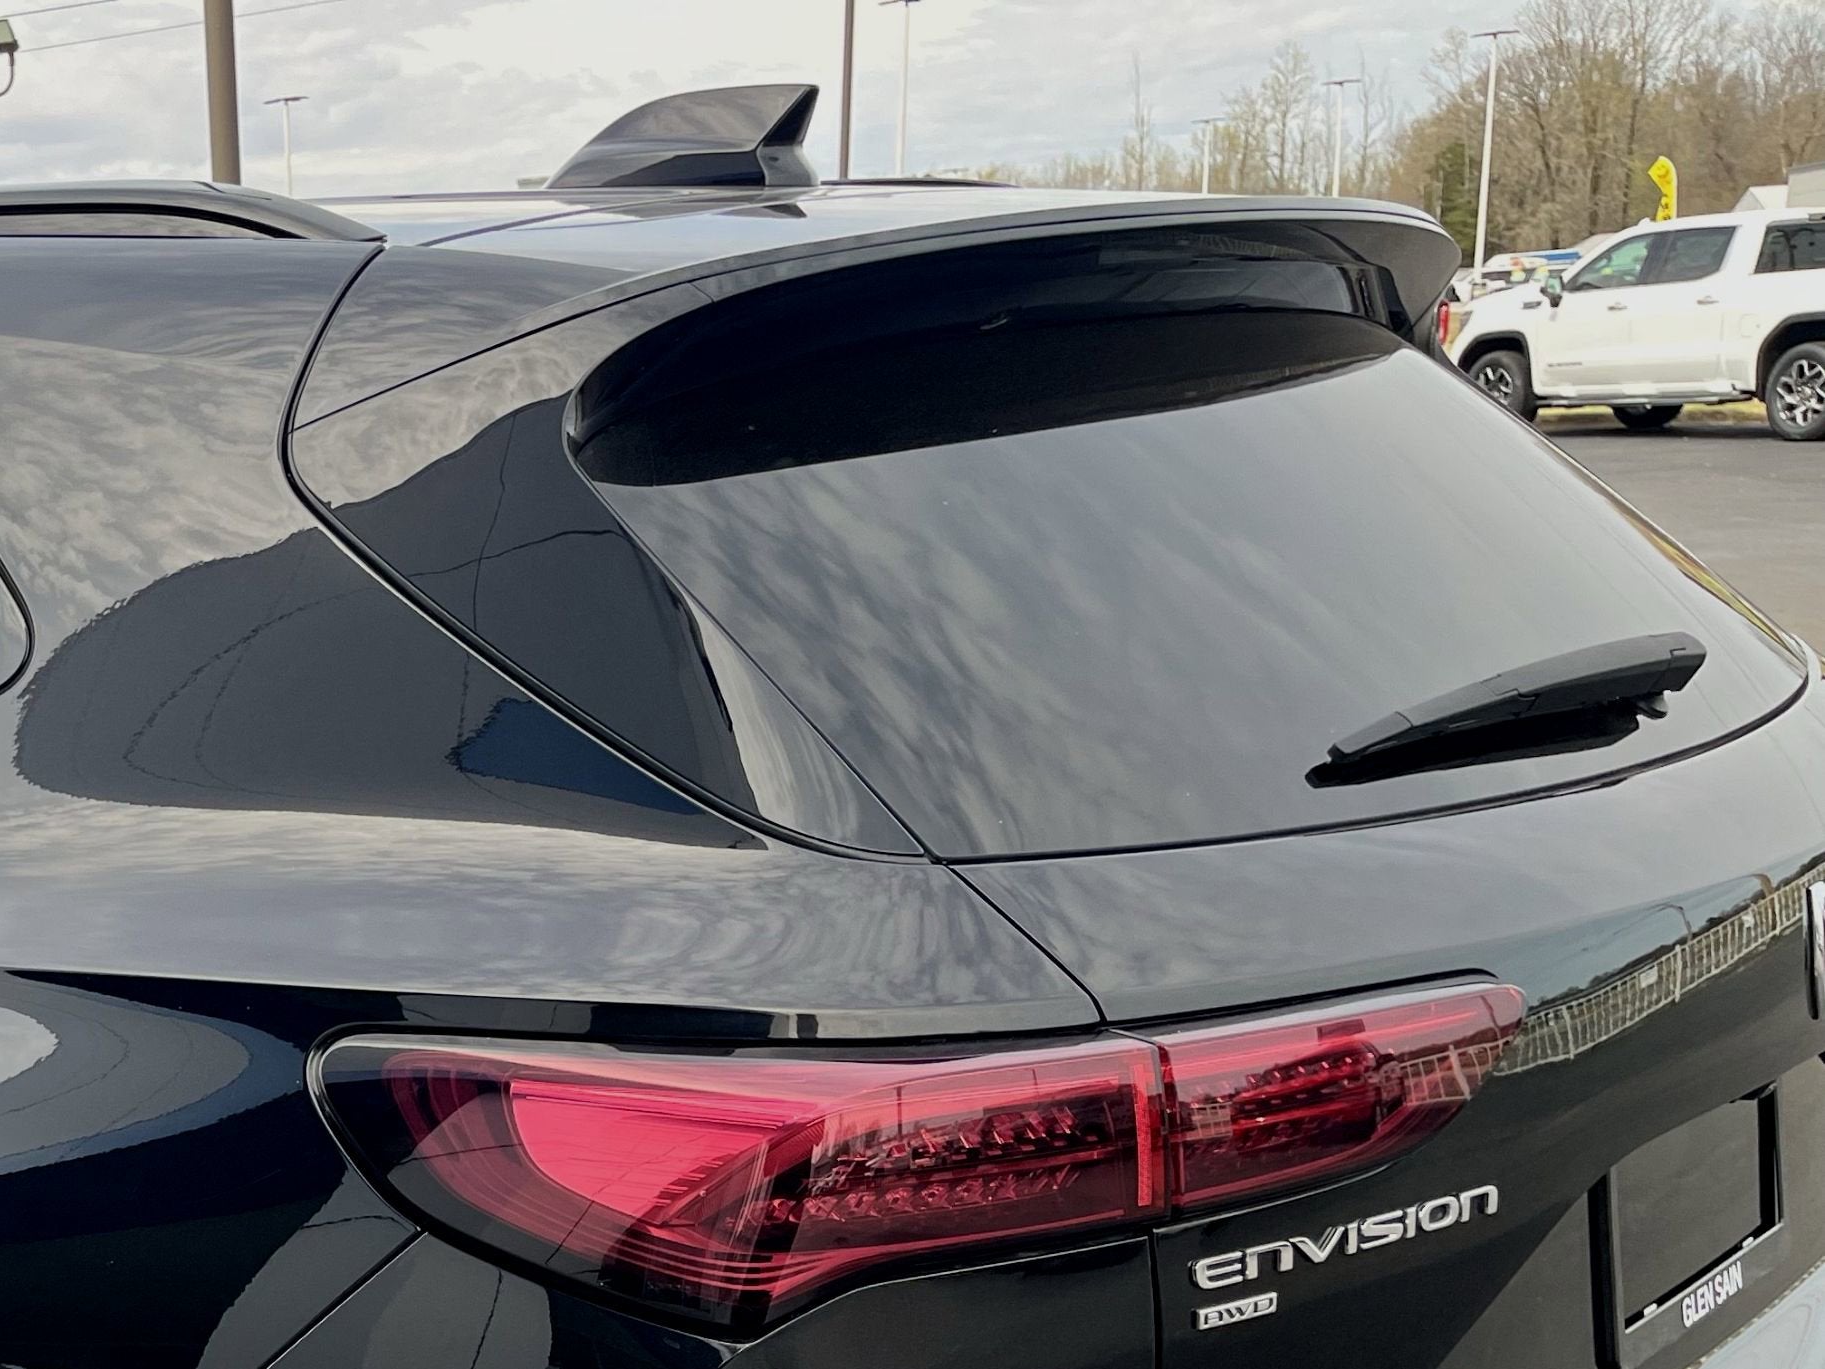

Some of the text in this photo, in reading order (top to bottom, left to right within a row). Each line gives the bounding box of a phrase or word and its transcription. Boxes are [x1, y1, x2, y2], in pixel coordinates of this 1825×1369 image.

[1190, 1185, 1499, 1290] ENVISION
[1201, 1295, 1276, 1328] AWD
[1682, 1260, 1743, 1328] GLEN SAIN
